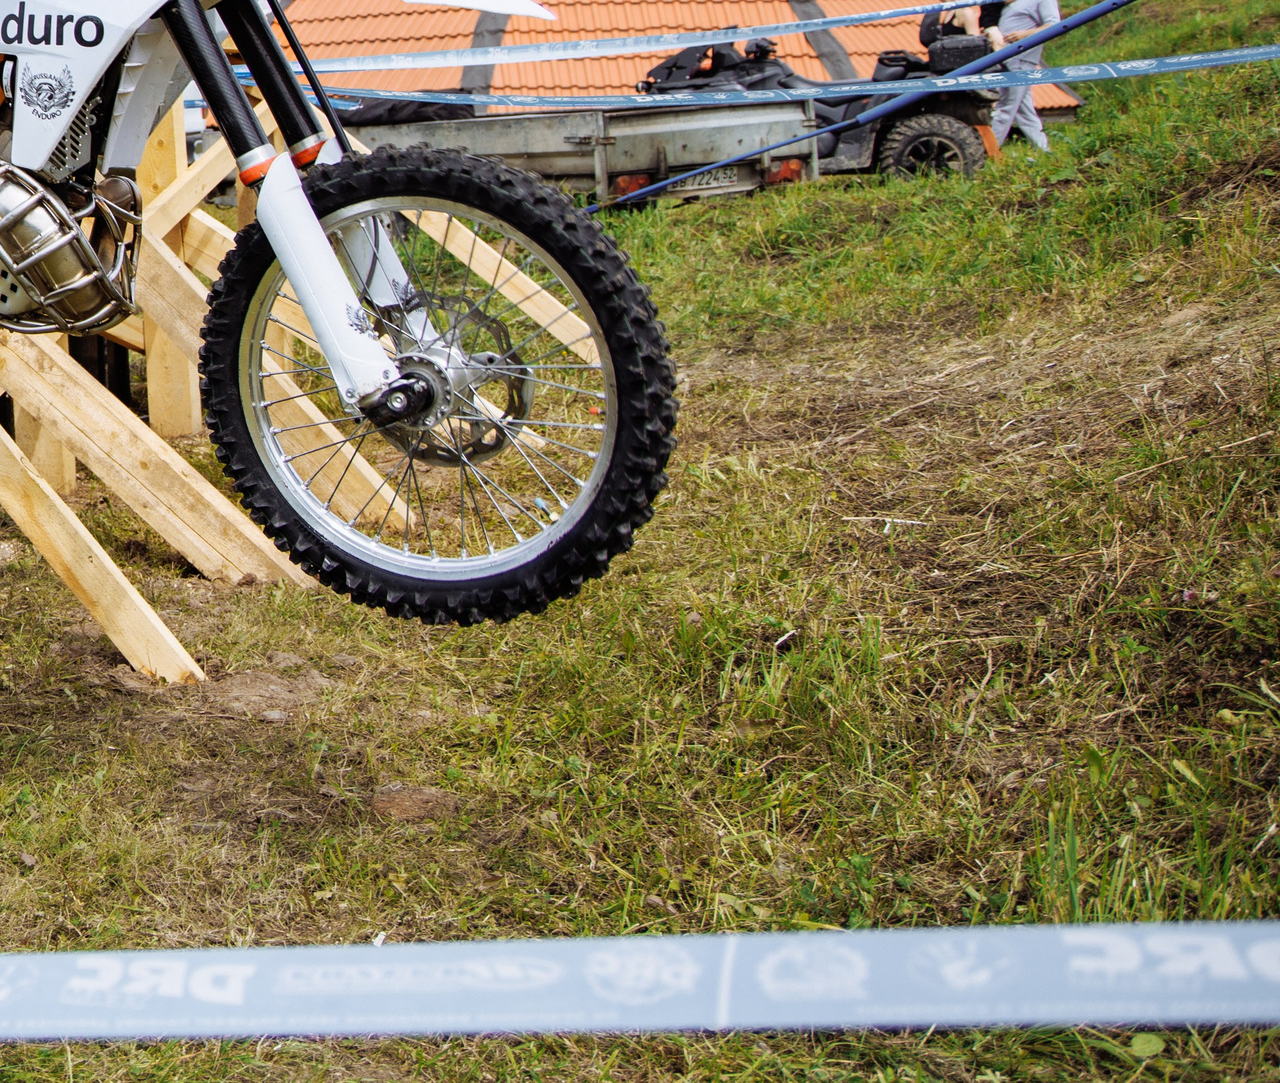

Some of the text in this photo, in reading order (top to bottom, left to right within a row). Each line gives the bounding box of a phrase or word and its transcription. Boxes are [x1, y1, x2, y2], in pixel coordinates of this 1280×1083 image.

[931, 72, 1002, 88] DRC
[630, 93, 695, 103] DRC
[31, 108, 62, 121] ENDURO
